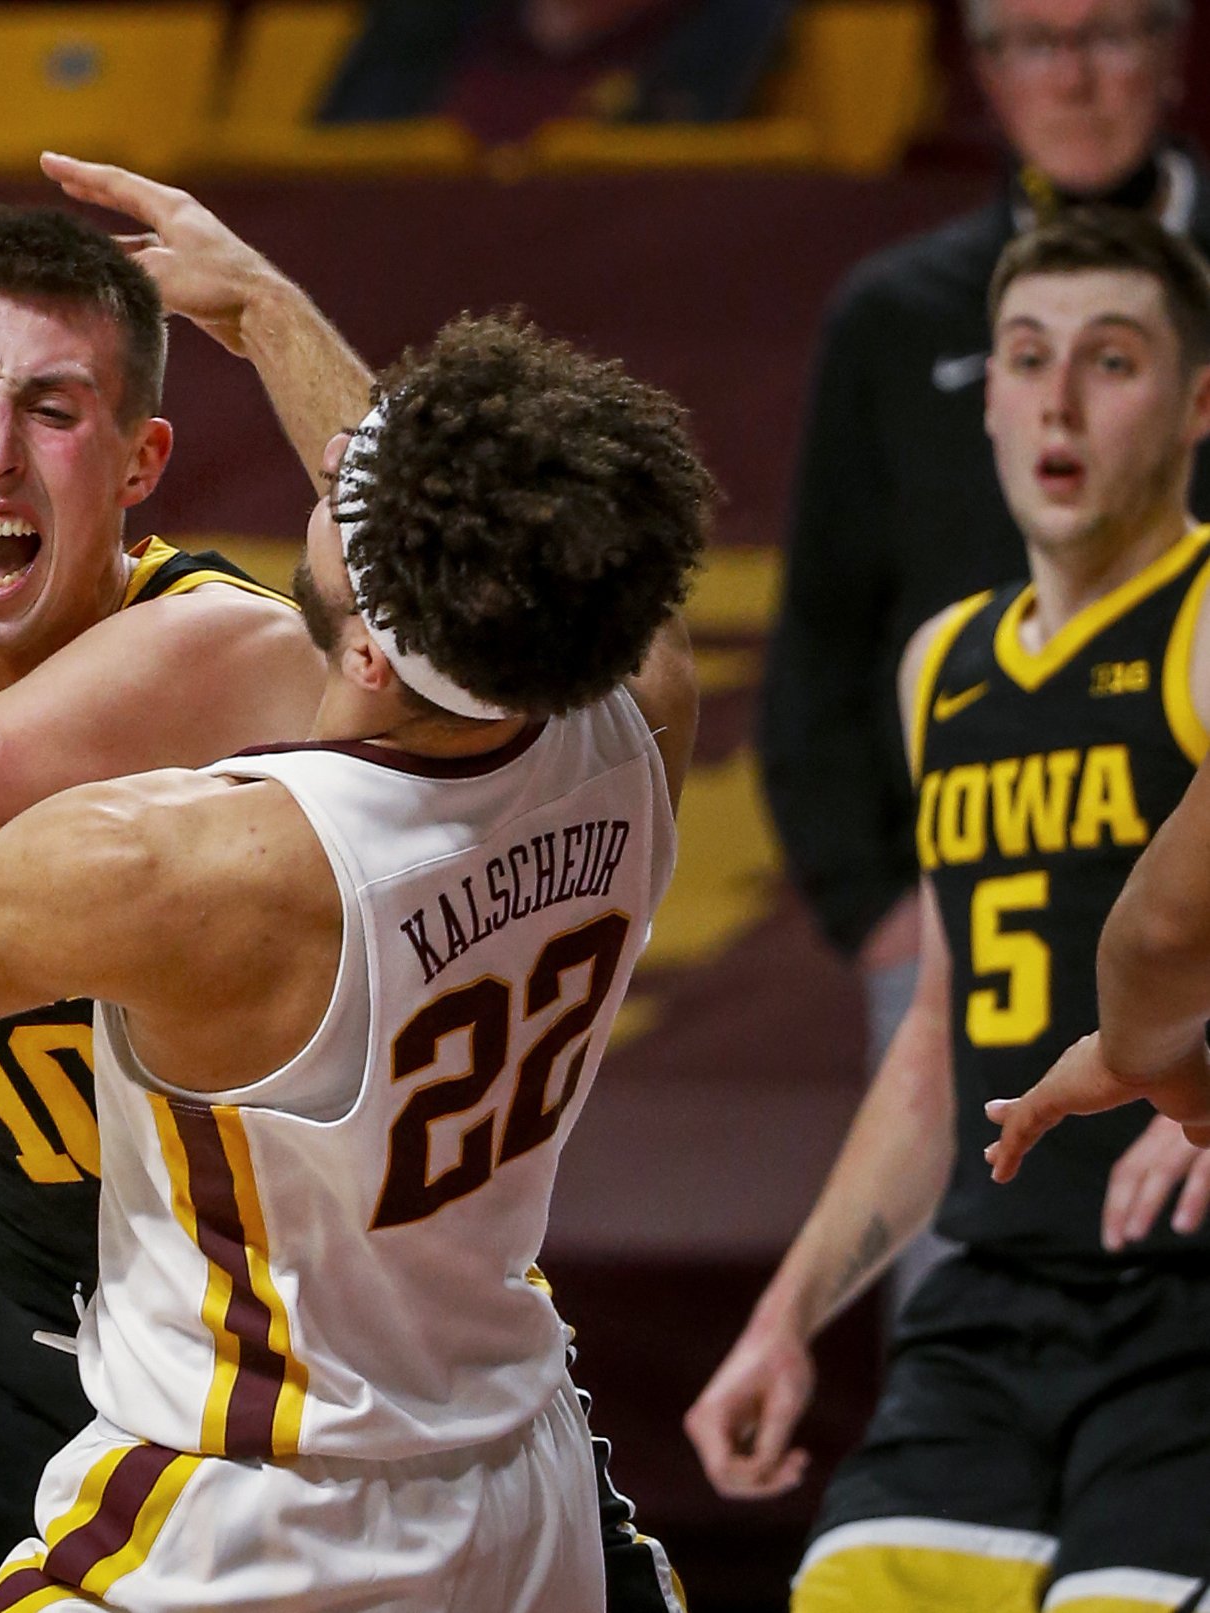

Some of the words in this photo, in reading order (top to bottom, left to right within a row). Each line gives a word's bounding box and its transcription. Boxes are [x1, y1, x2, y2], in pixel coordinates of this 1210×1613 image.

[917, 744, 1149, 871] IOWA
[400, 820, 630, 985] KALSCHEUR
[966, 871, 1051, 1048] 5
[368, 909, 631, 1231] 22
